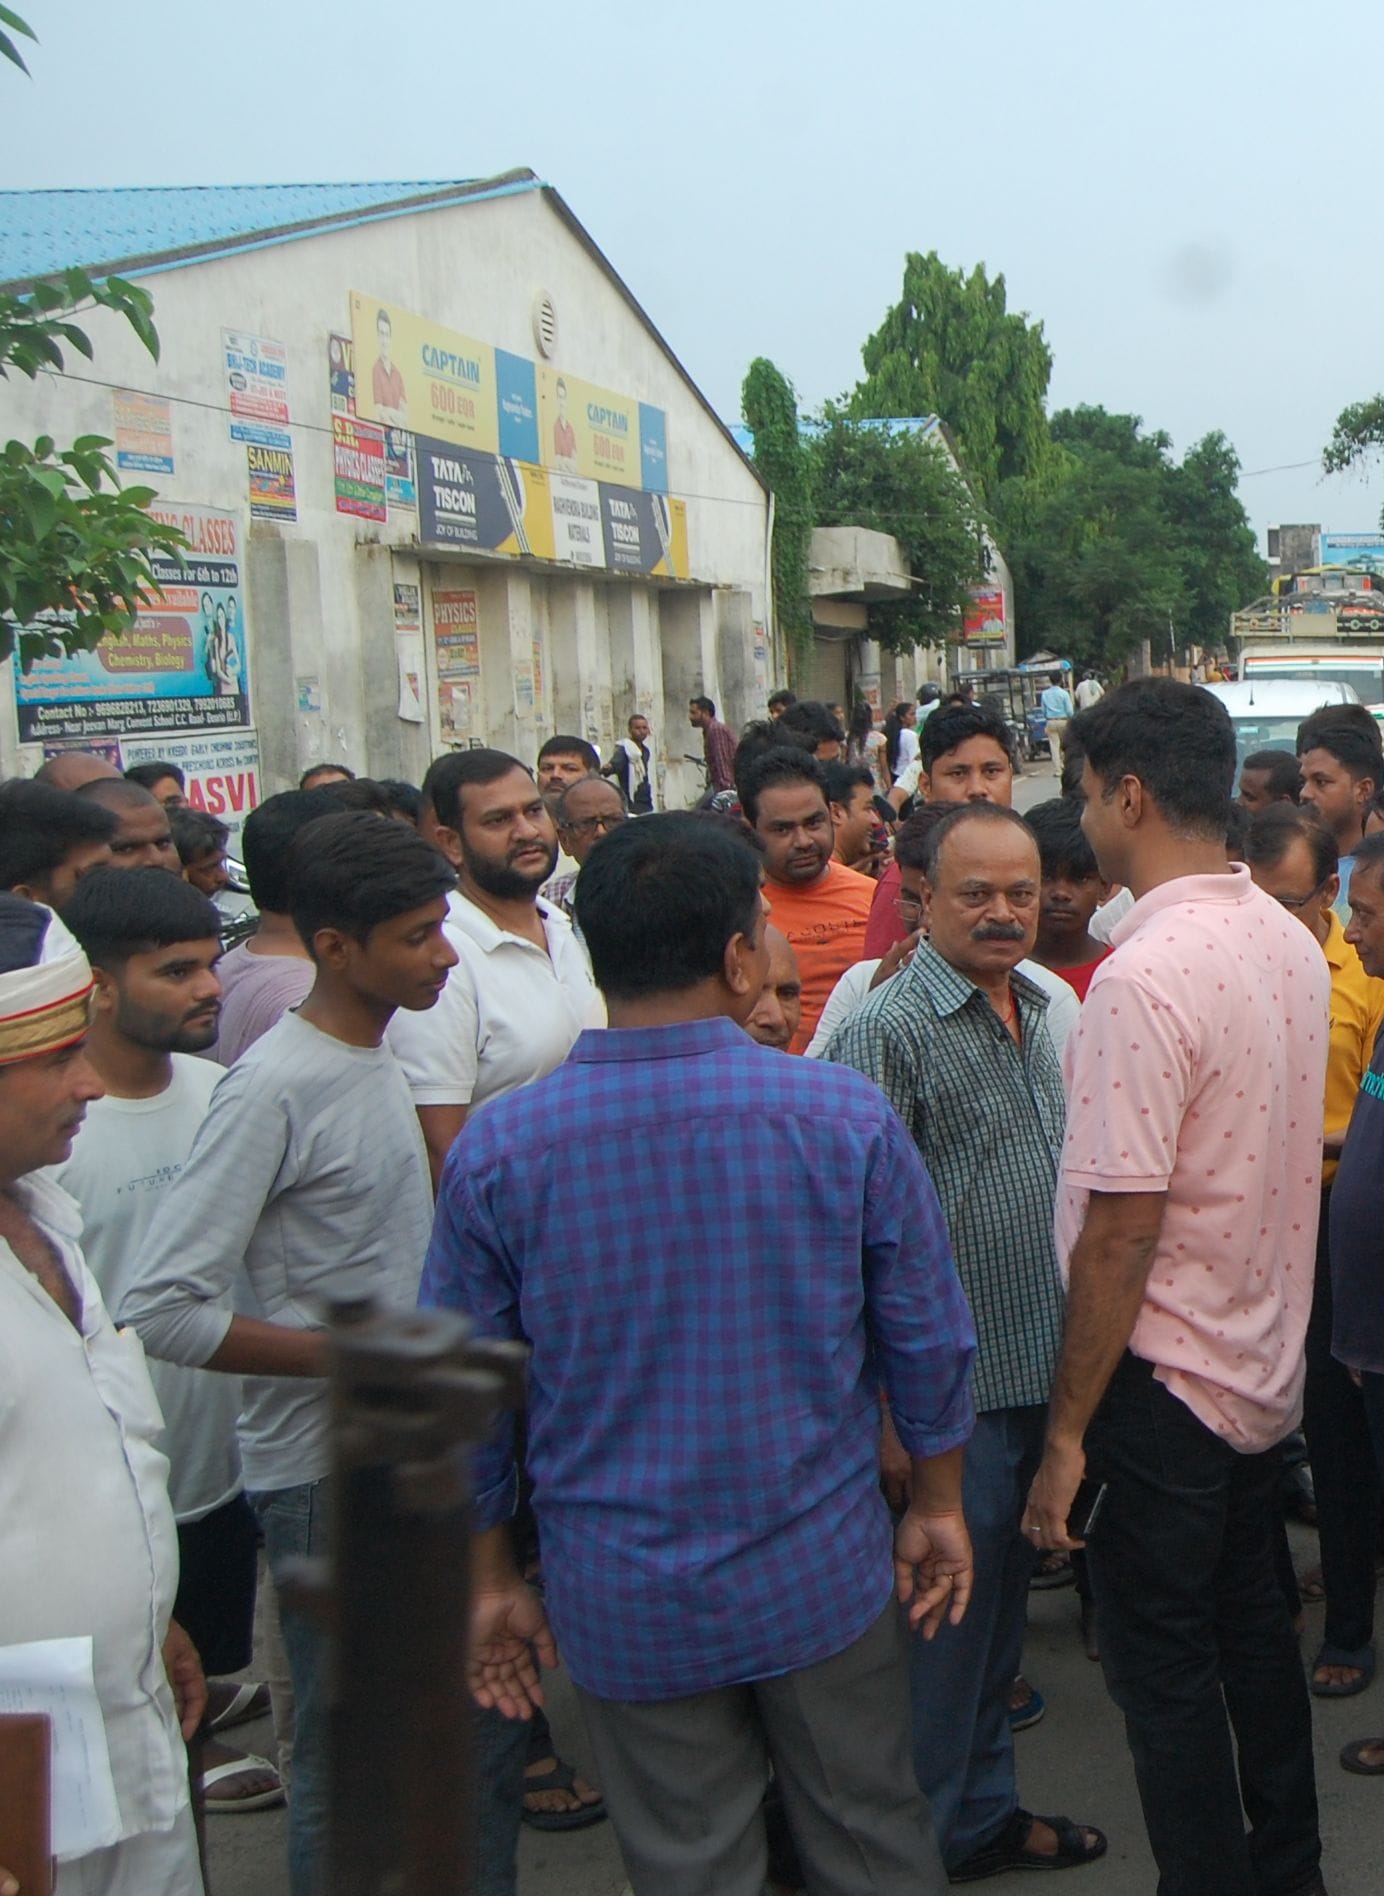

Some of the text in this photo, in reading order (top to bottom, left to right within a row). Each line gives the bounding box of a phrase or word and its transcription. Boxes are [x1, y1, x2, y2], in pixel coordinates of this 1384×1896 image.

[421, 343, 480, 383] CAPTAIN
[431, 381, 456, 415] 600
[586, 401, 628, 433] CAPTAIN
[431, 456, 463, 485] TATA
[432, 485, 476, 514] TISCON
[608, 498, 632, 520] TATA
[182, 514, 237, 556] CLASSES
[610, 521, 641, 543] TISCON
[151, 562, 183, 582] Classes
[434, 601, 477, 624] PHYSICS
[99, 633, 131, 649] nglish,
[161, 633, 193, 649] Physics
[37, 706, 73, 721] Contact
[74, 704, 88, 718] No
[188, 771, 258, 817] ASVI
